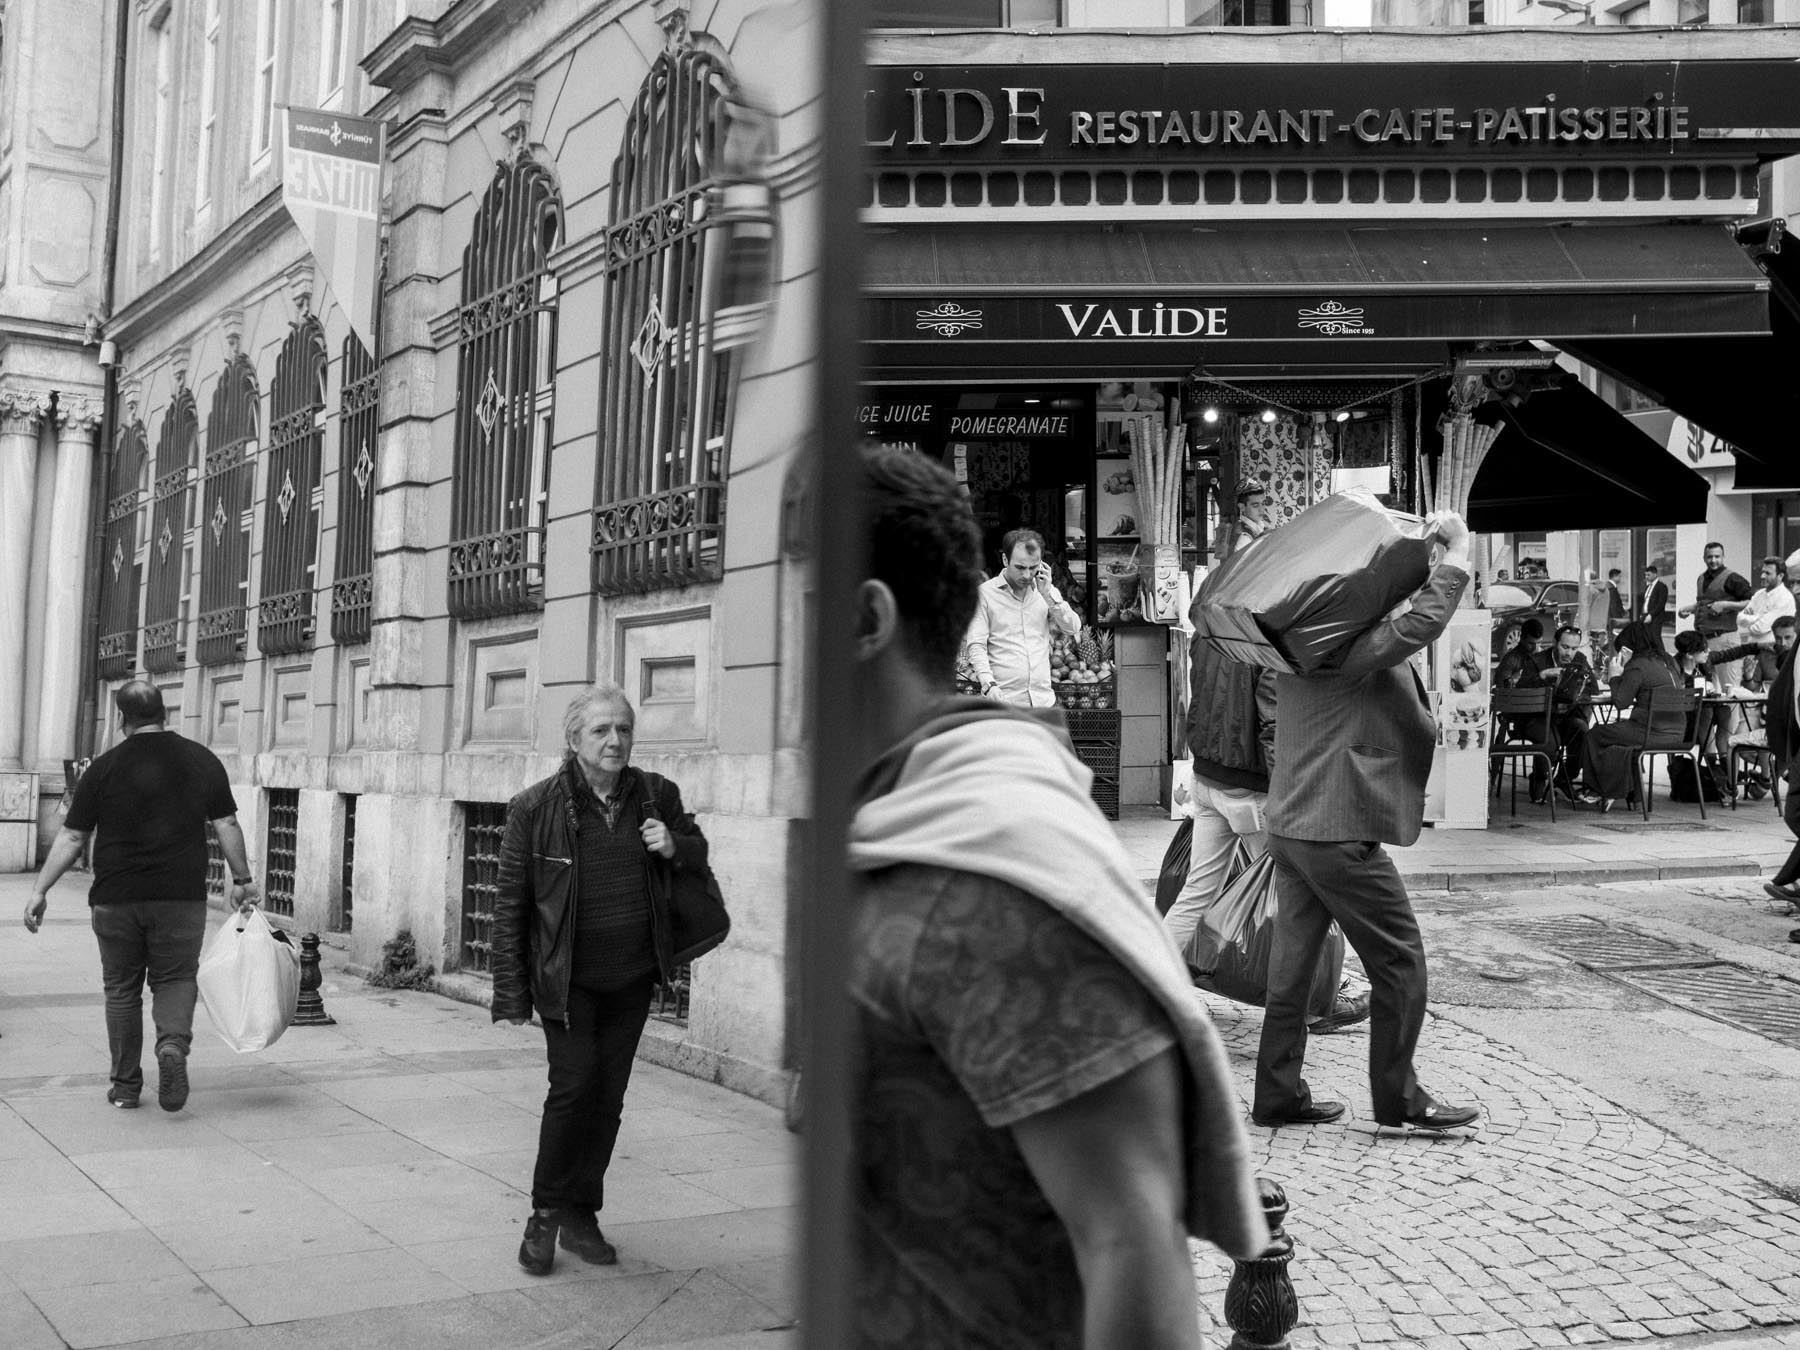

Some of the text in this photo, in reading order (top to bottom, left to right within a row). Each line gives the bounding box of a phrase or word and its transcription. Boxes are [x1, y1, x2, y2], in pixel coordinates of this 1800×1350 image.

[1056, 302, 1228, 337] VALİDE
[1341, 327, 1361, 335] Since
[884, 404, 932, 422] JUICE
[951, 416, 1069, 434] POMEGRANATE
